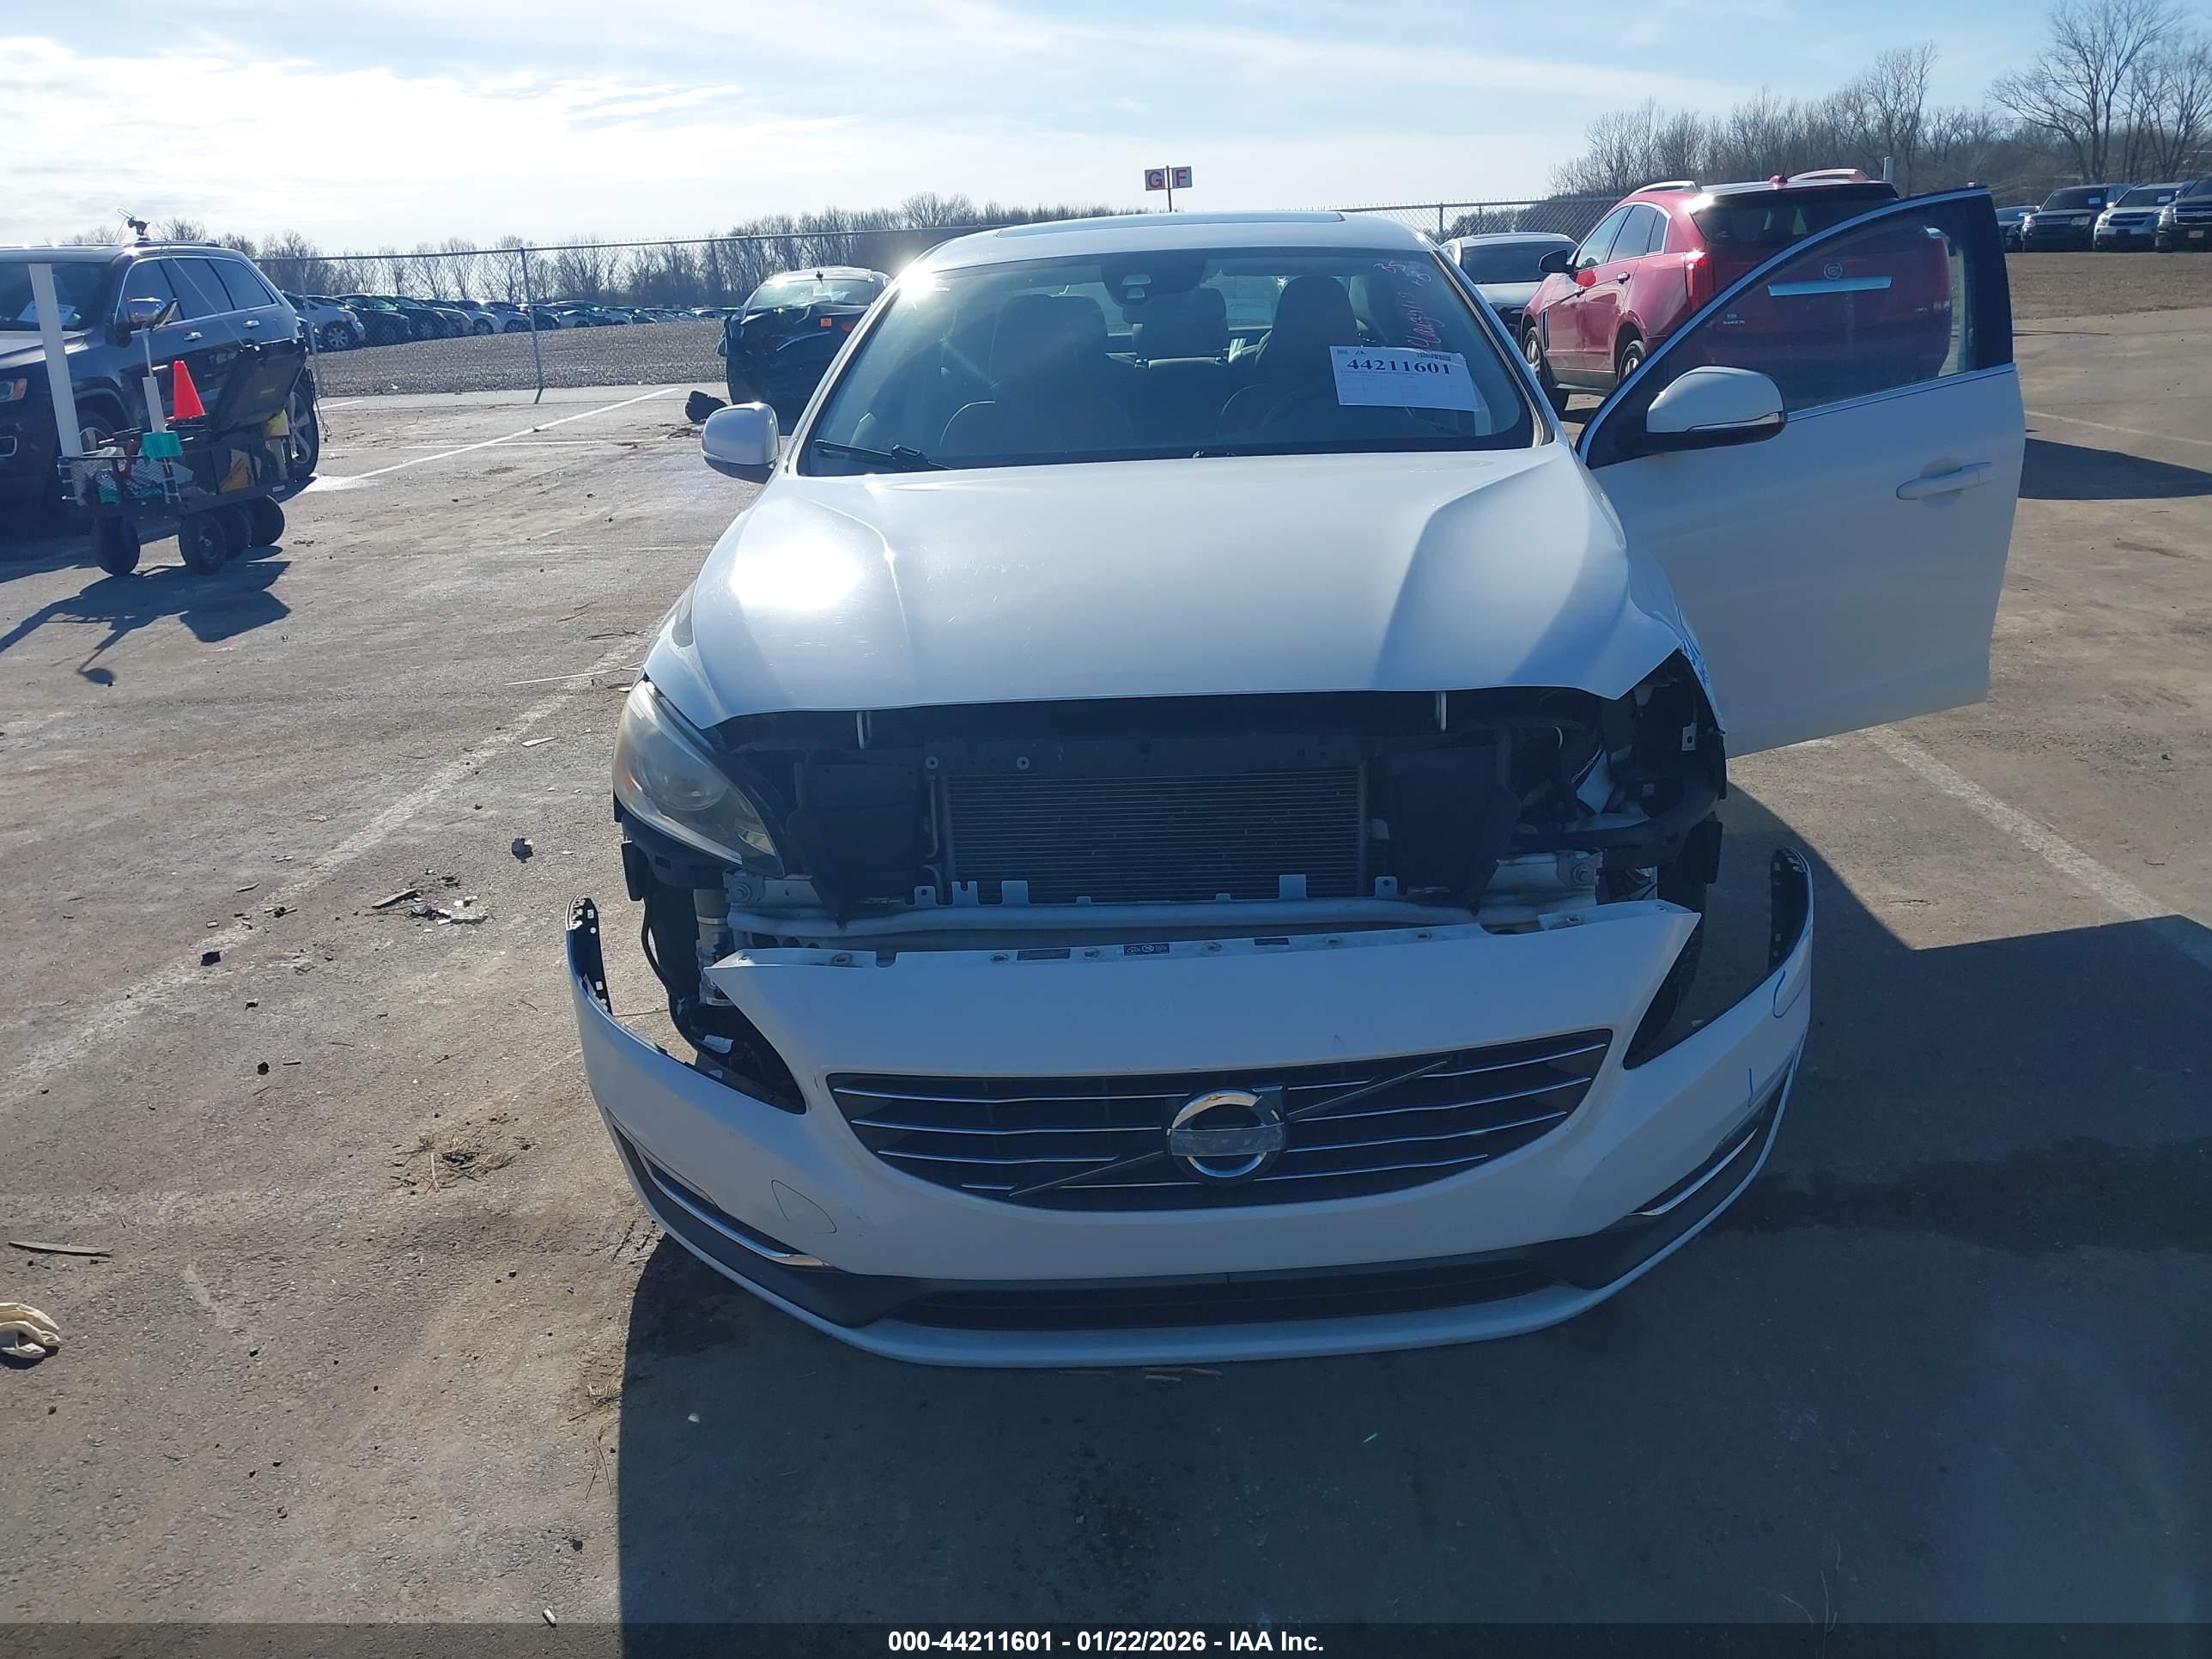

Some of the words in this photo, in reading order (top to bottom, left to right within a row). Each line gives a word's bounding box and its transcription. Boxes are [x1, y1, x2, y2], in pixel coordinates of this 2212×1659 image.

[1148, 171, 1163, 188] G
[1176, 169, 1188, 186] F
[1346, 358, 1451, 374] 44211601
